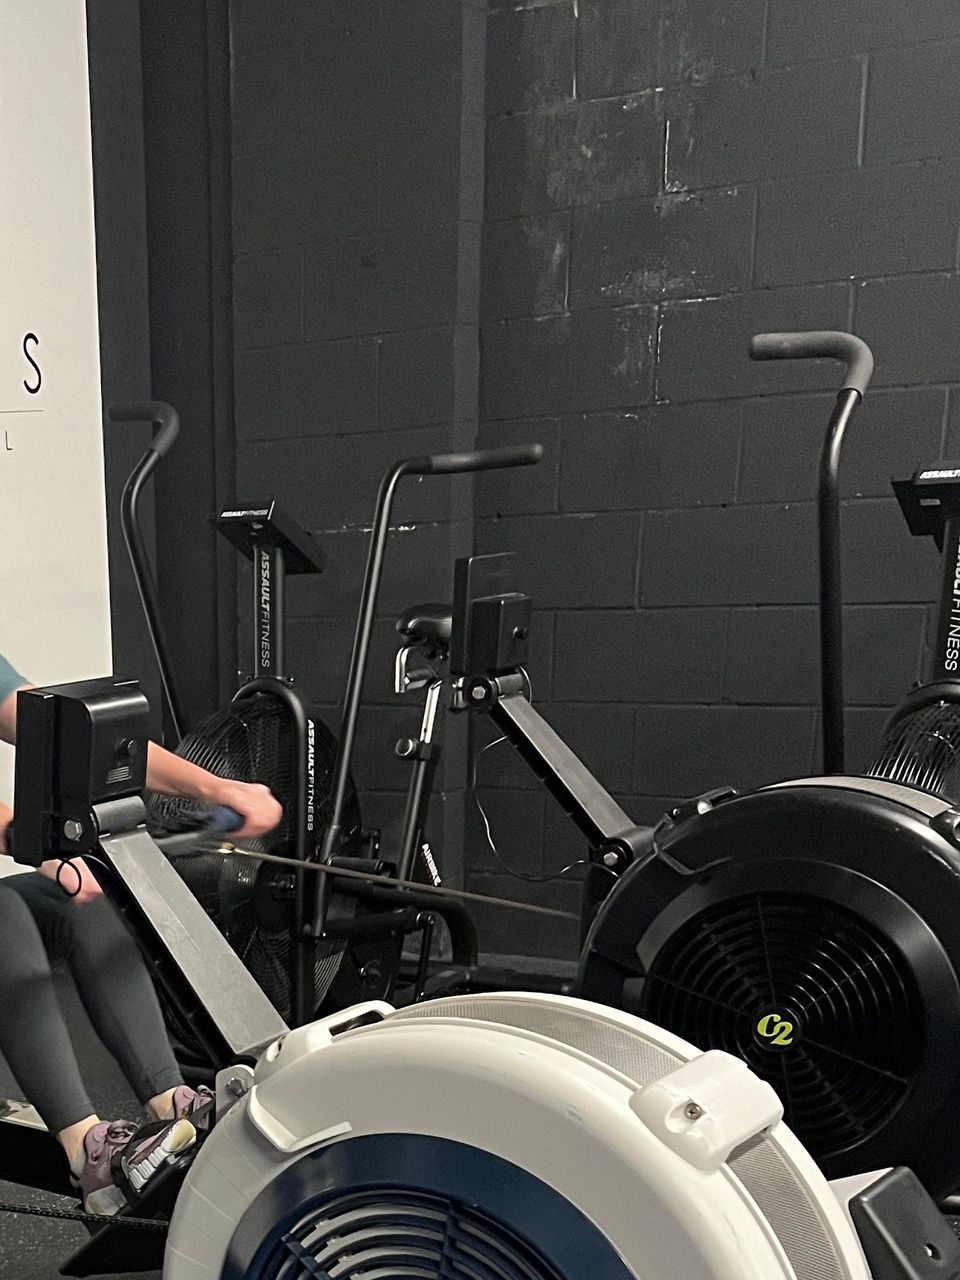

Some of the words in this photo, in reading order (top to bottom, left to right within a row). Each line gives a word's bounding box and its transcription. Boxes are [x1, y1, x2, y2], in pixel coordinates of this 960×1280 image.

[919, 469, 960, 480] ASSAULT
[261, 550, 270, 668] ASSAULTFITNESS
[307, 719, 315, 831] ASSAULTFITNESS
[757, 1013, 793, 1046] C2
